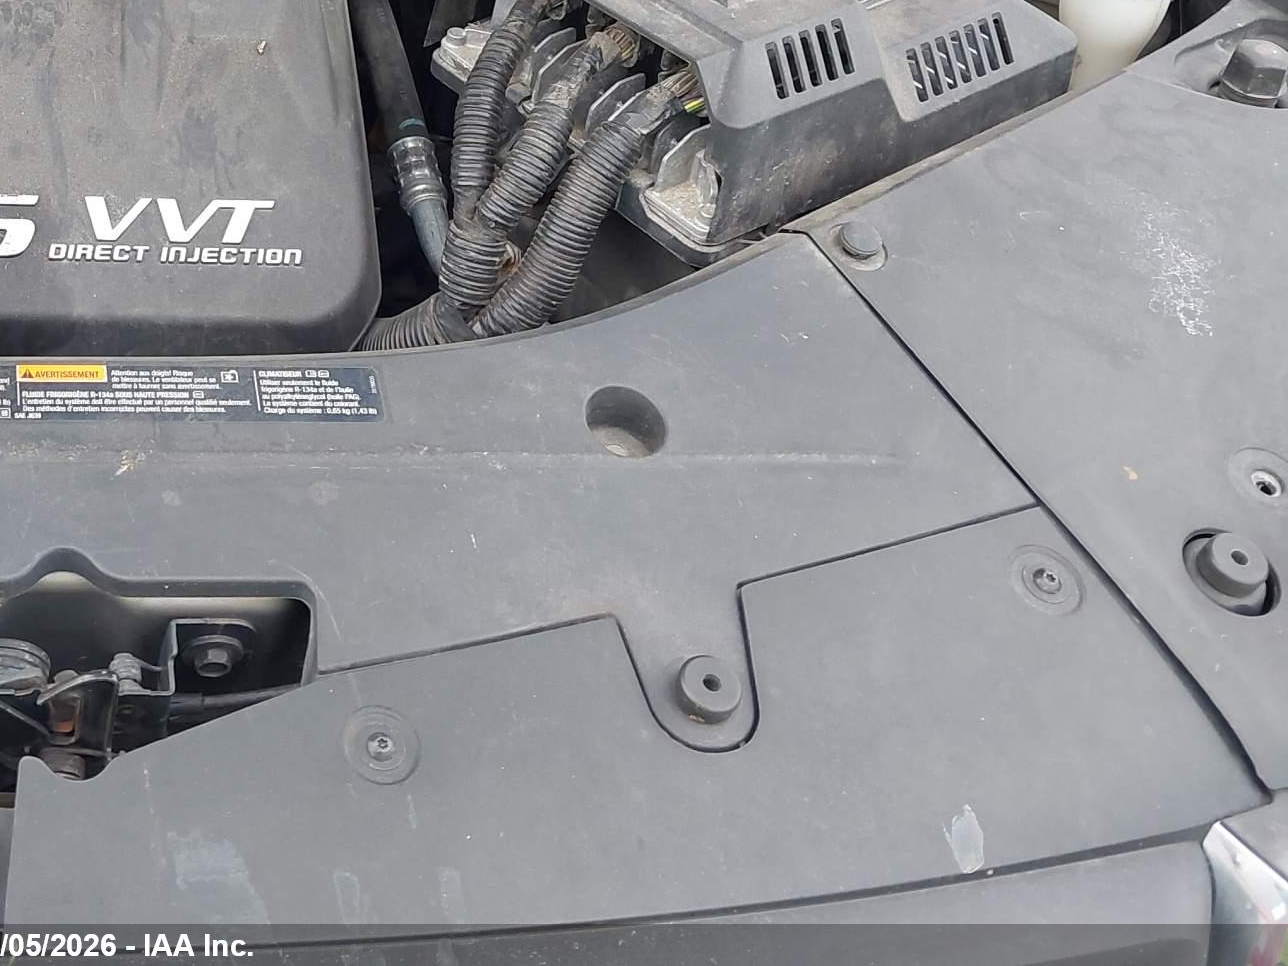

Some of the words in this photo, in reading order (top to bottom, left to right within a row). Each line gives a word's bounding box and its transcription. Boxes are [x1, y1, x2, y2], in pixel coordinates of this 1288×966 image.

[85, 195, 275, 244] VVT
[49, 244, 149, 262] DIRECT
[160, 246, 302, 265] INJECTION
